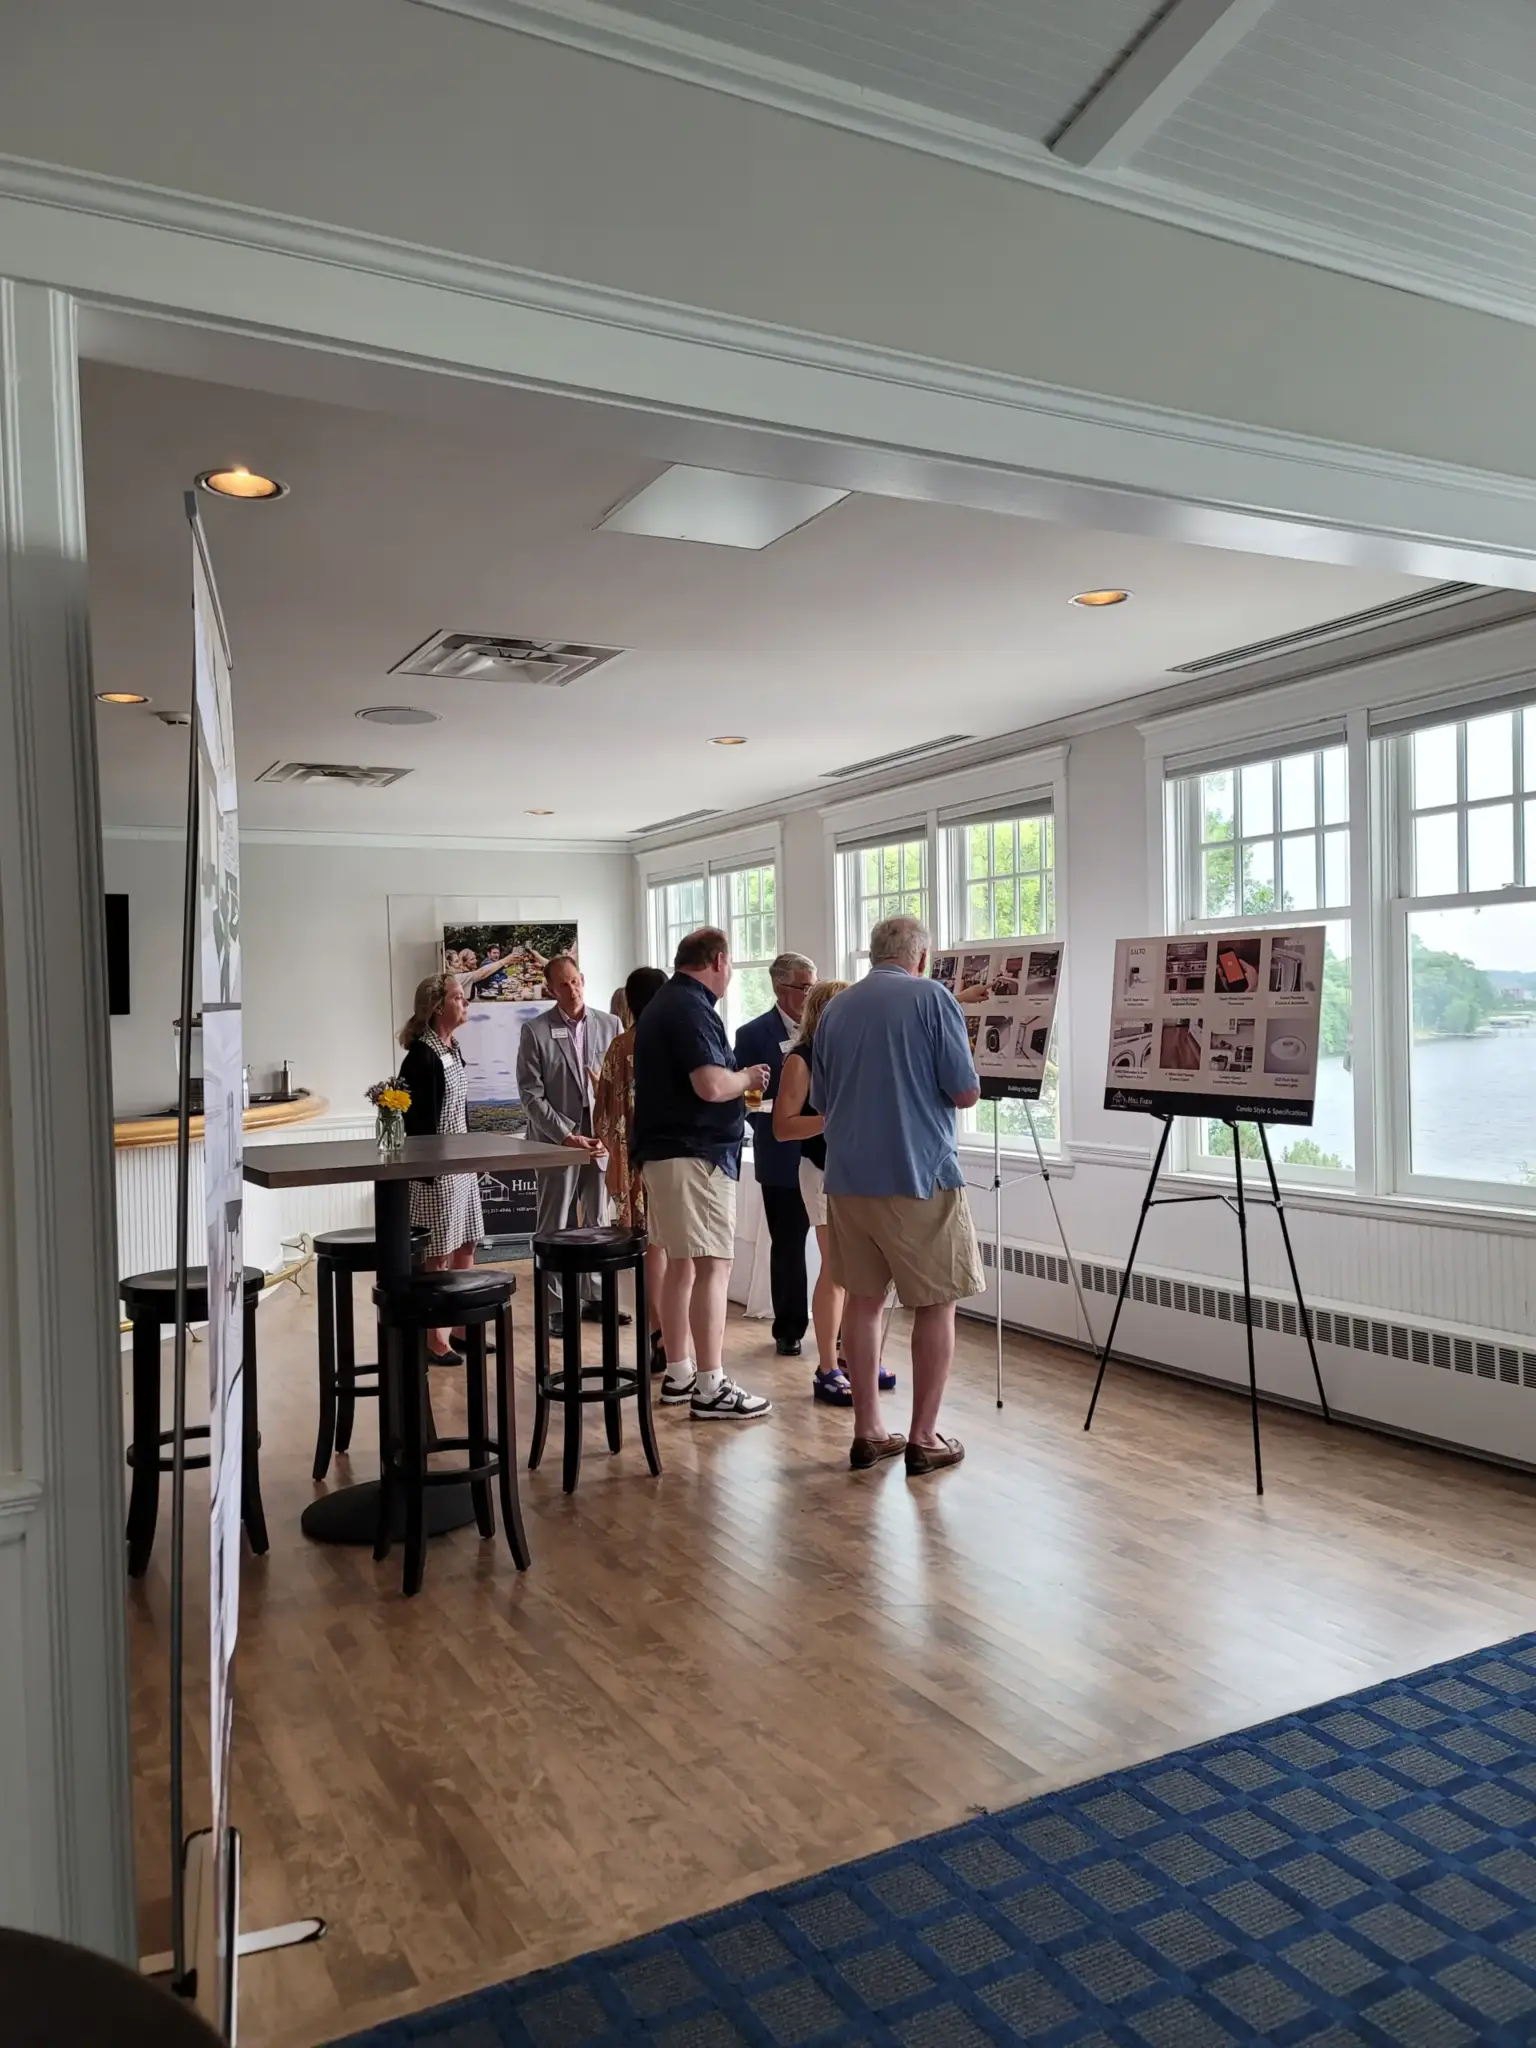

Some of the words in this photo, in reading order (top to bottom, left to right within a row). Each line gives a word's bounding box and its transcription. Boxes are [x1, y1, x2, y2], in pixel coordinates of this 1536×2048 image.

[1236, 1105, 1253, 1113] Condo
[1253, 1106, 1266, 1114] Style
[1272, 1108, 1309, 1117] Specifications
